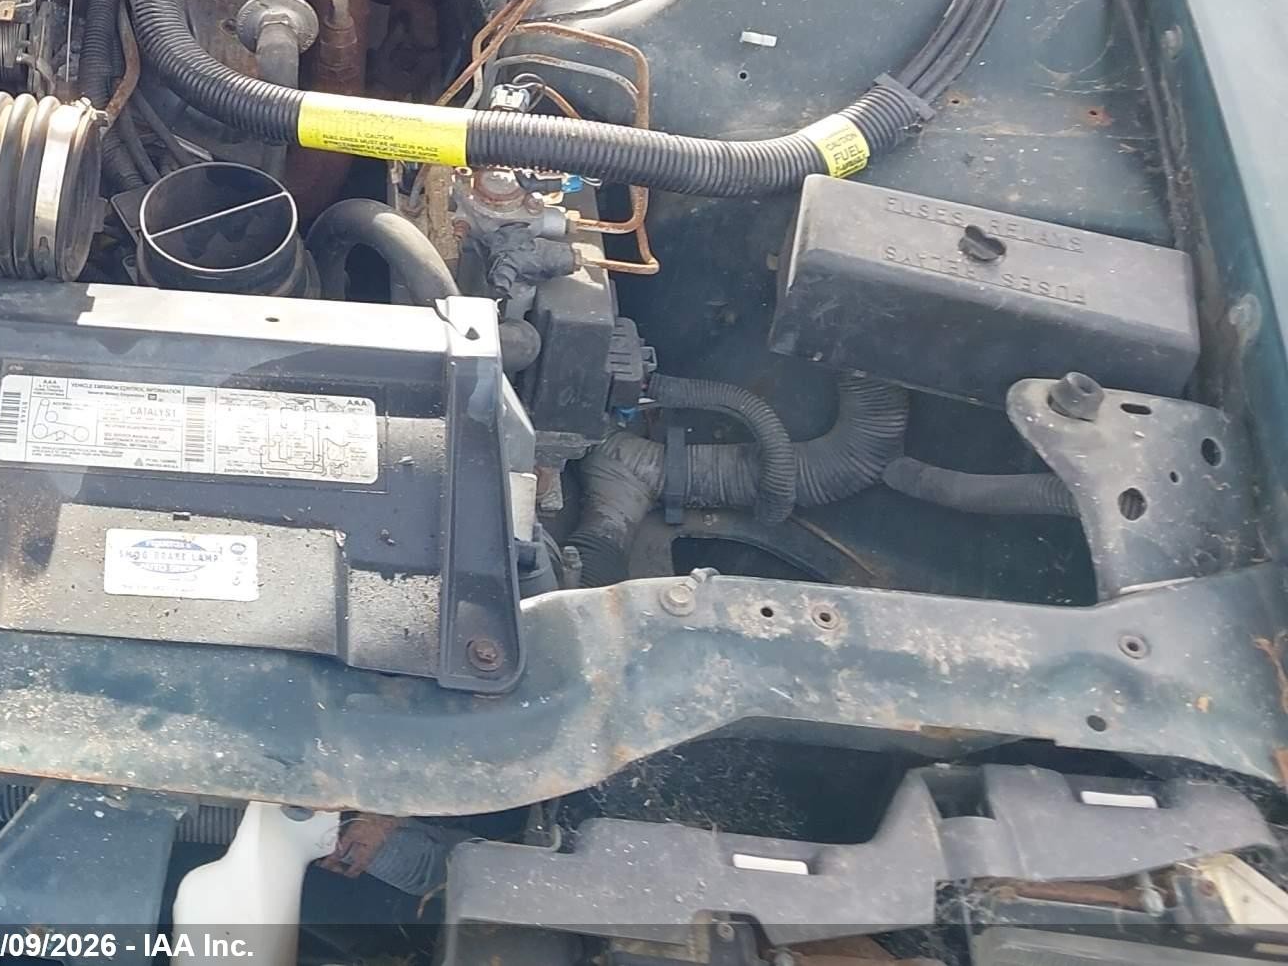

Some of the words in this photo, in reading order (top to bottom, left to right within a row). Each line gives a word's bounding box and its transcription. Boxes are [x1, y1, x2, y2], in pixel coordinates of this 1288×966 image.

[833, 145, 864, 165] FUEL
[885, 196, 966, 227] FUSES
[986, 218, 1083, 253] RELAYS
[130, 406, 176, 418] CATALYST
[192, 552, 219, 563] LAMP
